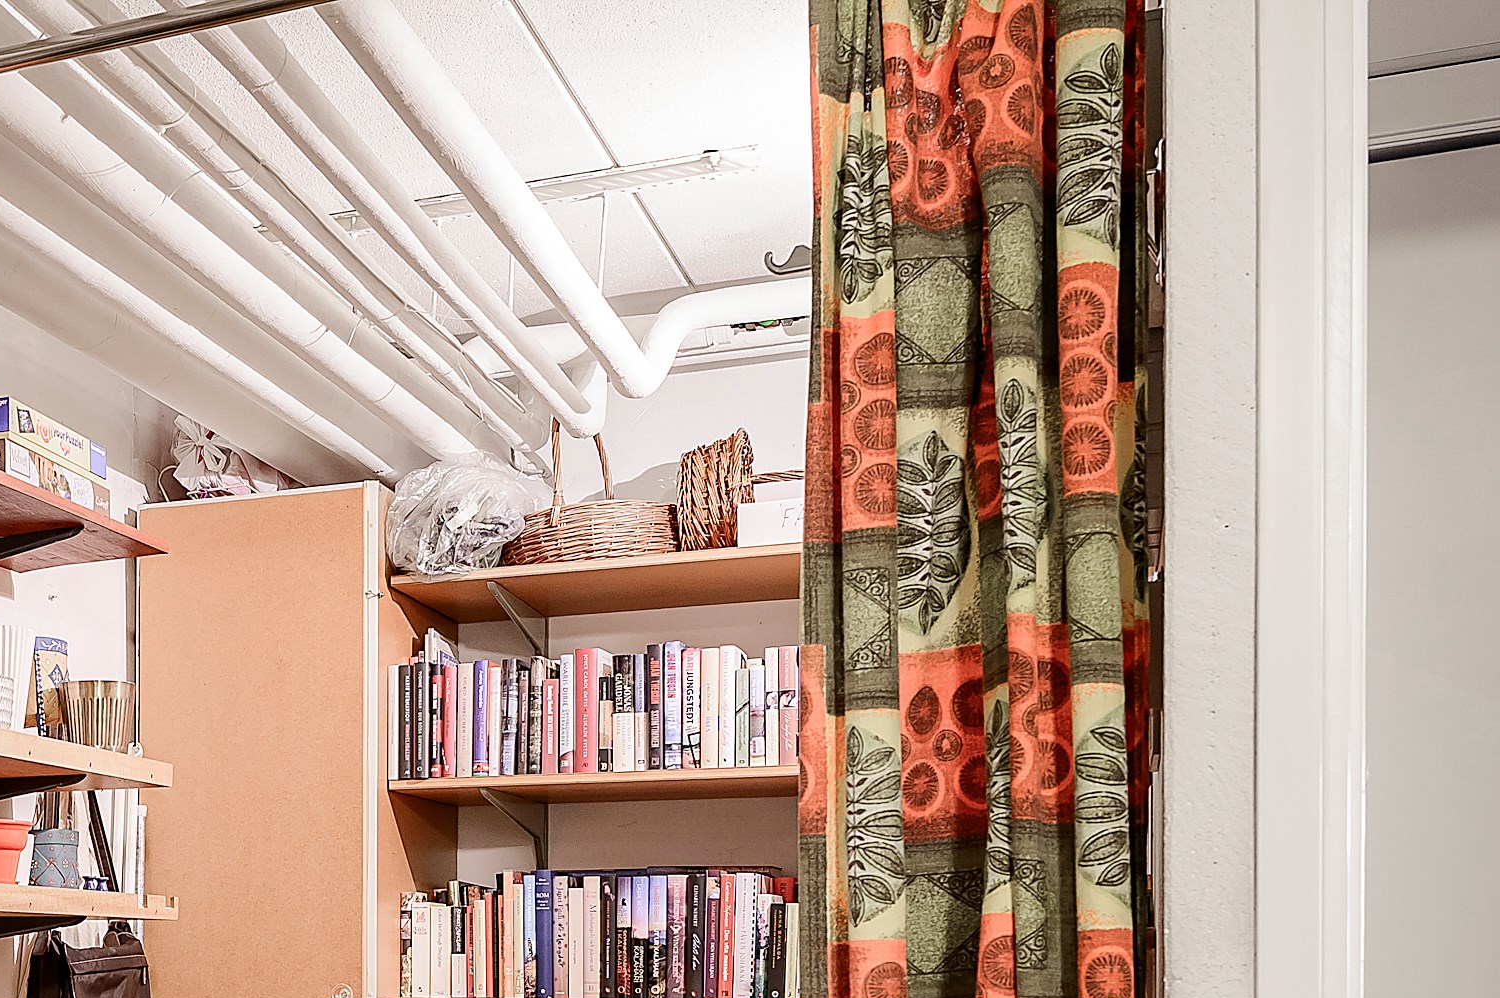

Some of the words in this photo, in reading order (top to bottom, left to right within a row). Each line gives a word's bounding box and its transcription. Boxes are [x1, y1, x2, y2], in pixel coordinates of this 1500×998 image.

[650, 658, 660, 677] JOHAN
[667, 651, 676, 671] JOHAN
[615, 673, 623, 712] GARDELL
[623, 685, 632, 712] JONAS
[650, 680, 660, 705] THEORIN
[667, 674, 676, 699] THEORIN
[686, 672, 694, 723] JUNGSTEDT
[650, 710, 660, 748] SKUMTIMMEN
